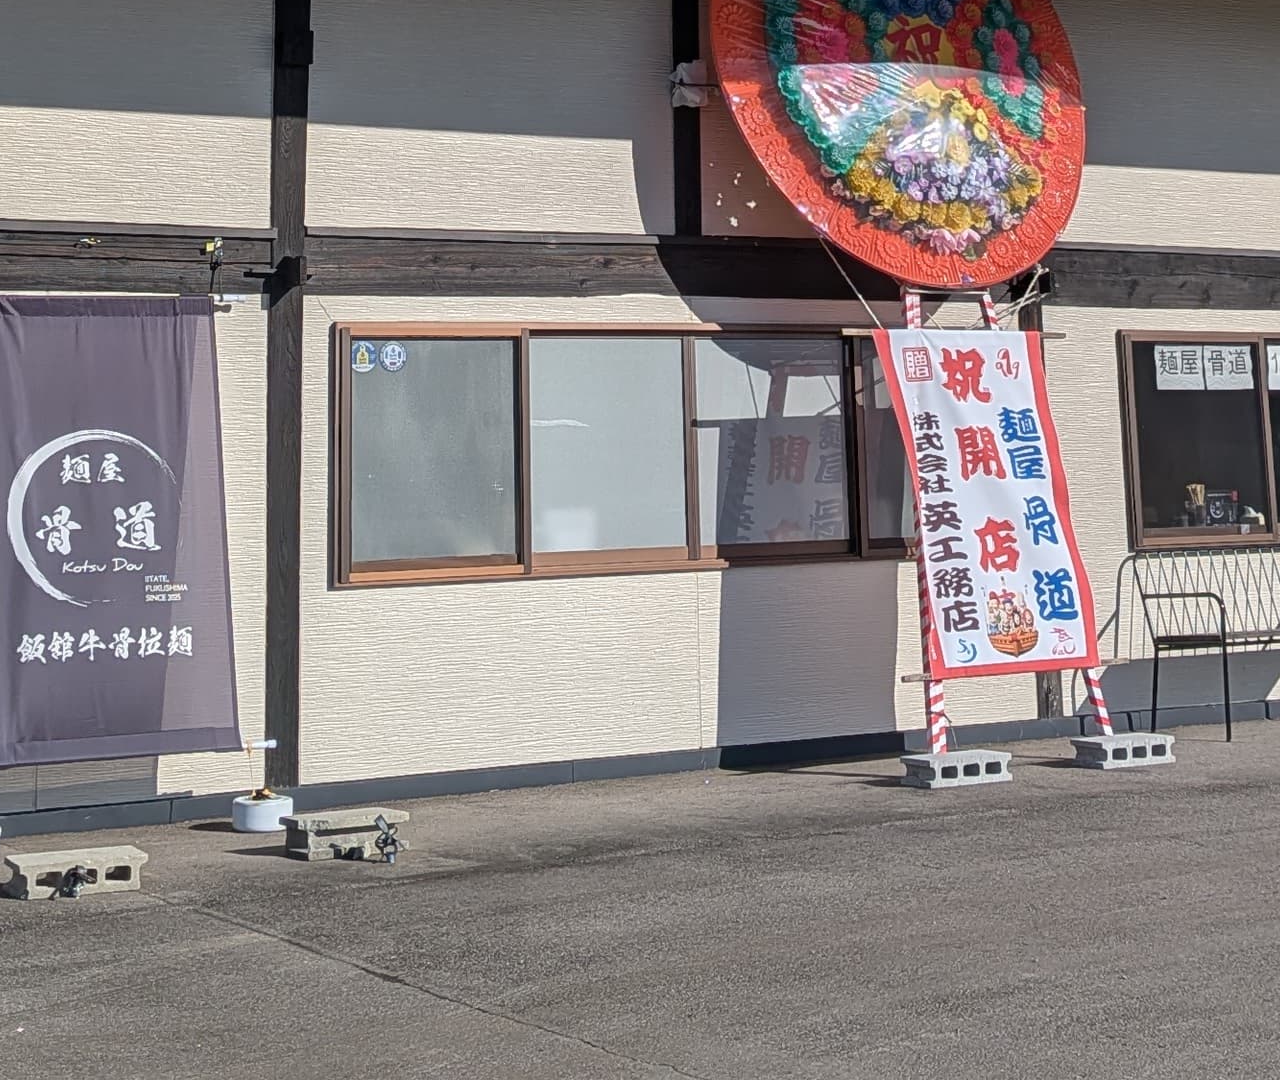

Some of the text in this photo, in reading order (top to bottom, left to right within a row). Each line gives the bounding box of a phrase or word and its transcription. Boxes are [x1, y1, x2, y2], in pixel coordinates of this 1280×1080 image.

[904, 349, 931, 380] 贈
[60, 453, 125, 484] 麺屋
[939, 347, 1020, 573] 祝開店
[913, 411, 981, 633] 株式会社英工務店
[62, 557, 144, 574] Kotsu Dou
[144, 584, 188, 592] FUKUSHIMA
[145, 593, 167, 602] SINCE
